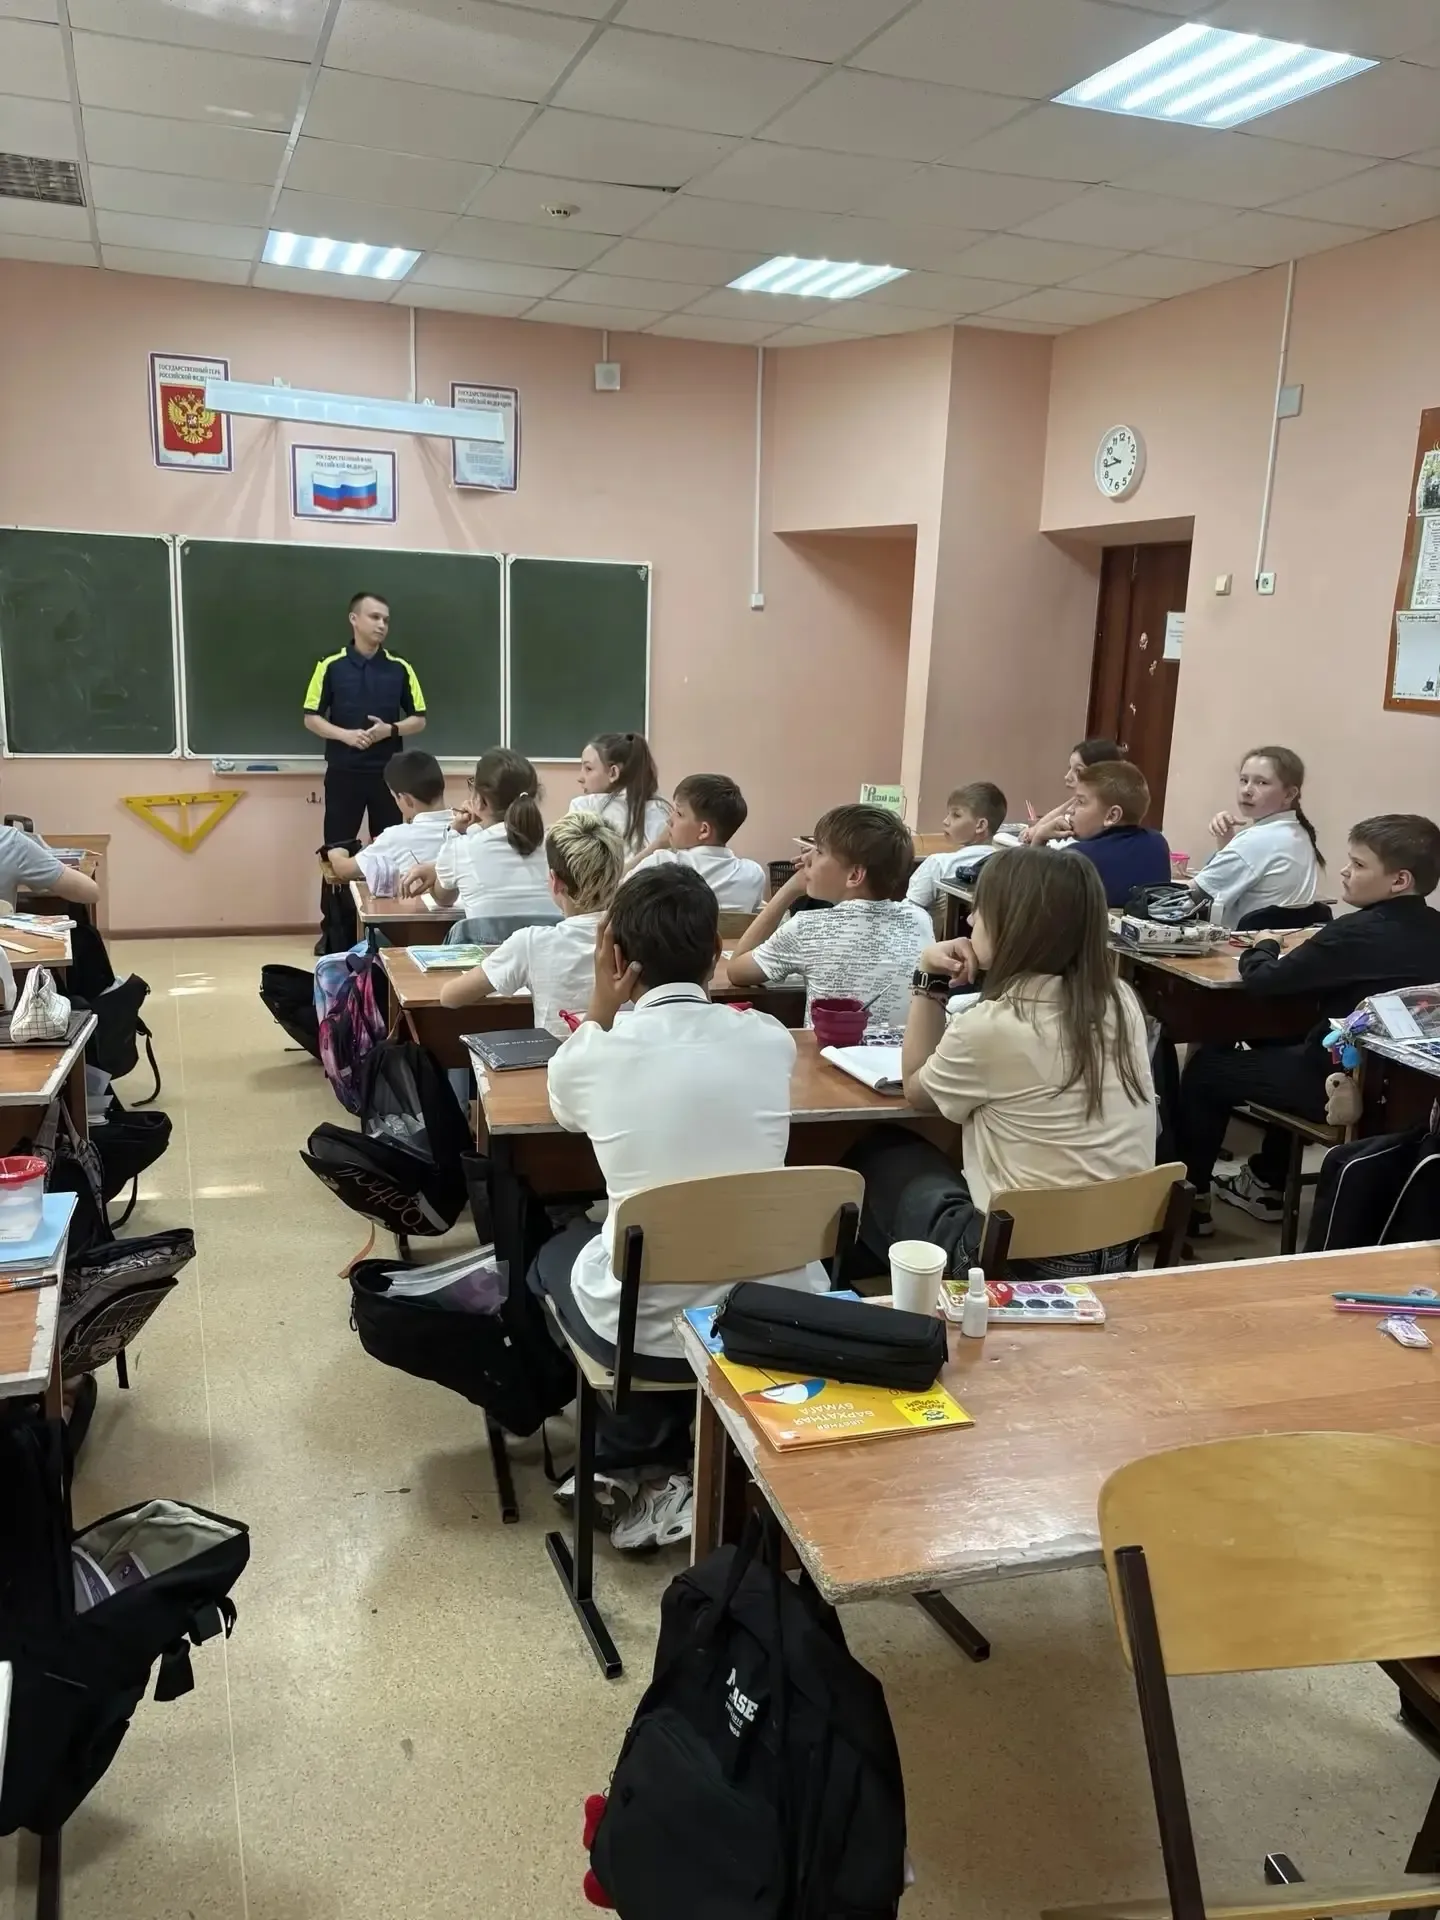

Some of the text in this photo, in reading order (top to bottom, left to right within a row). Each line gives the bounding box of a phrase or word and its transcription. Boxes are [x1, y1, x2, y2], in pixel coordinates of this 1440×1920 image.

[1113, 437, 1118, 445] 11
[1119, 432, 1125, 441] 12
[1107, 447, 1113, 455] 10
[1114, 481, 1120, 490] 6
[800, 1402, 855, 1415] БУМАГА
[792, 1410, 876, 1426] БАРХАТНАЯ
[816, 1419, 866, 1431] ЦВЕТНАЯ
